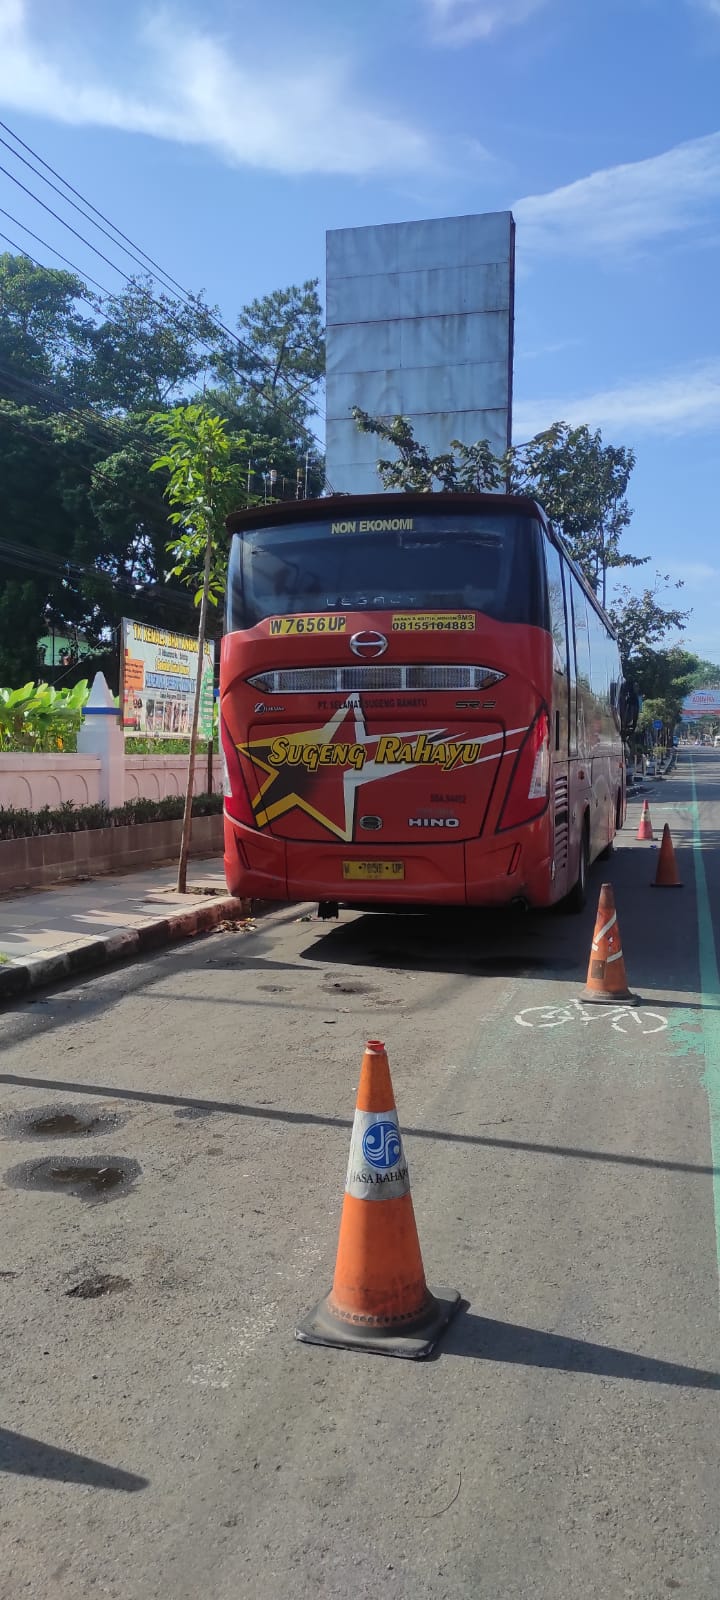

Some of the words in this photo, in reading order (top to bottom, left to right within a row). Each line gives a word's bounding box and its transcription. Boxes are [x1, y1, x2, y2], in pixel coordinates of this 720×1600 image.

[331, 521, 356, 534] NON
[359, 518, 413, 533] EKONOMI
[271, 620, 282, 634] W
[285, 617, 326, 633] 7656
[328, 616, 346, 631] UP
[392, 621, 475, 630] 08155104883
[408, 818, 460, 828] HINO
[353, 1172, 374, 1184] JASA
